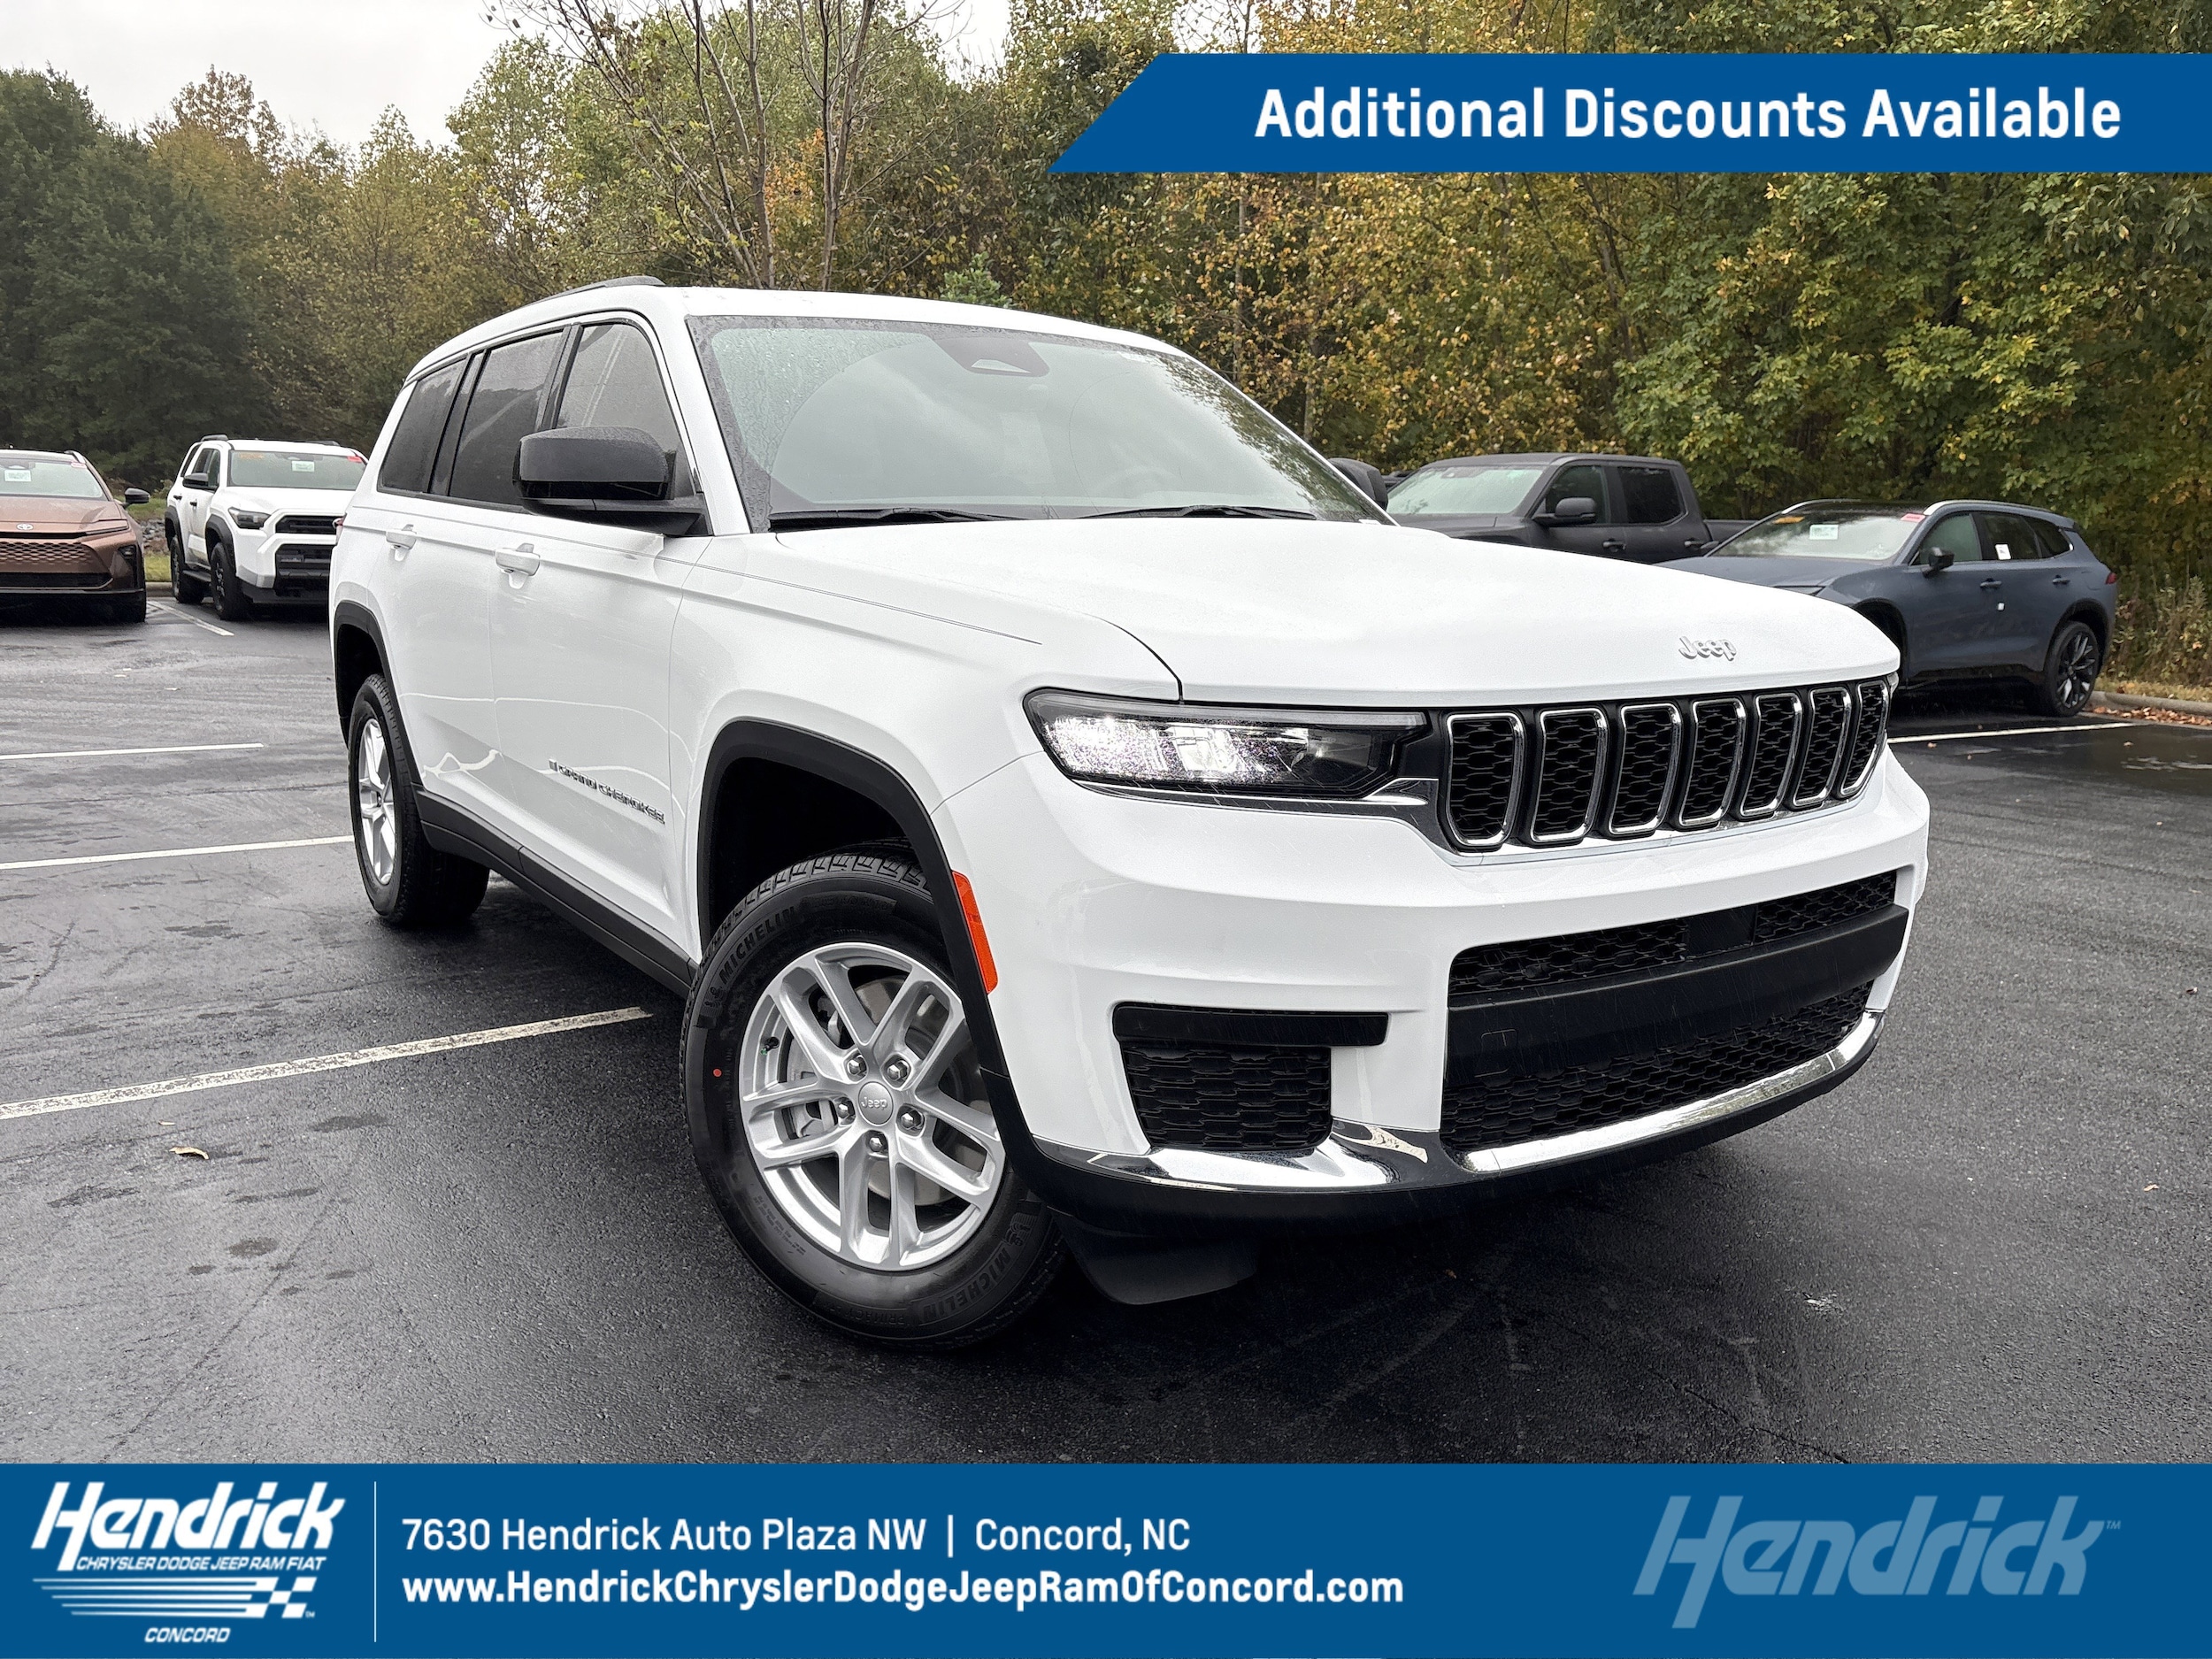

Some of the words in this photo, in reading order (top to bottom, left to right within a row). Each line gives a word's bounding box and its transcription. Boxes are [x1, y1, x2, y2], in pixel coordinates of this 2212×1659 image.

[1678, 635, 1737, 662] Jeep
[718, 905, 795, 985] MICHELIN
[860, 1095, 888, 1111] Jeep
[923, 1247, 1012, 1321] MICHELIN
